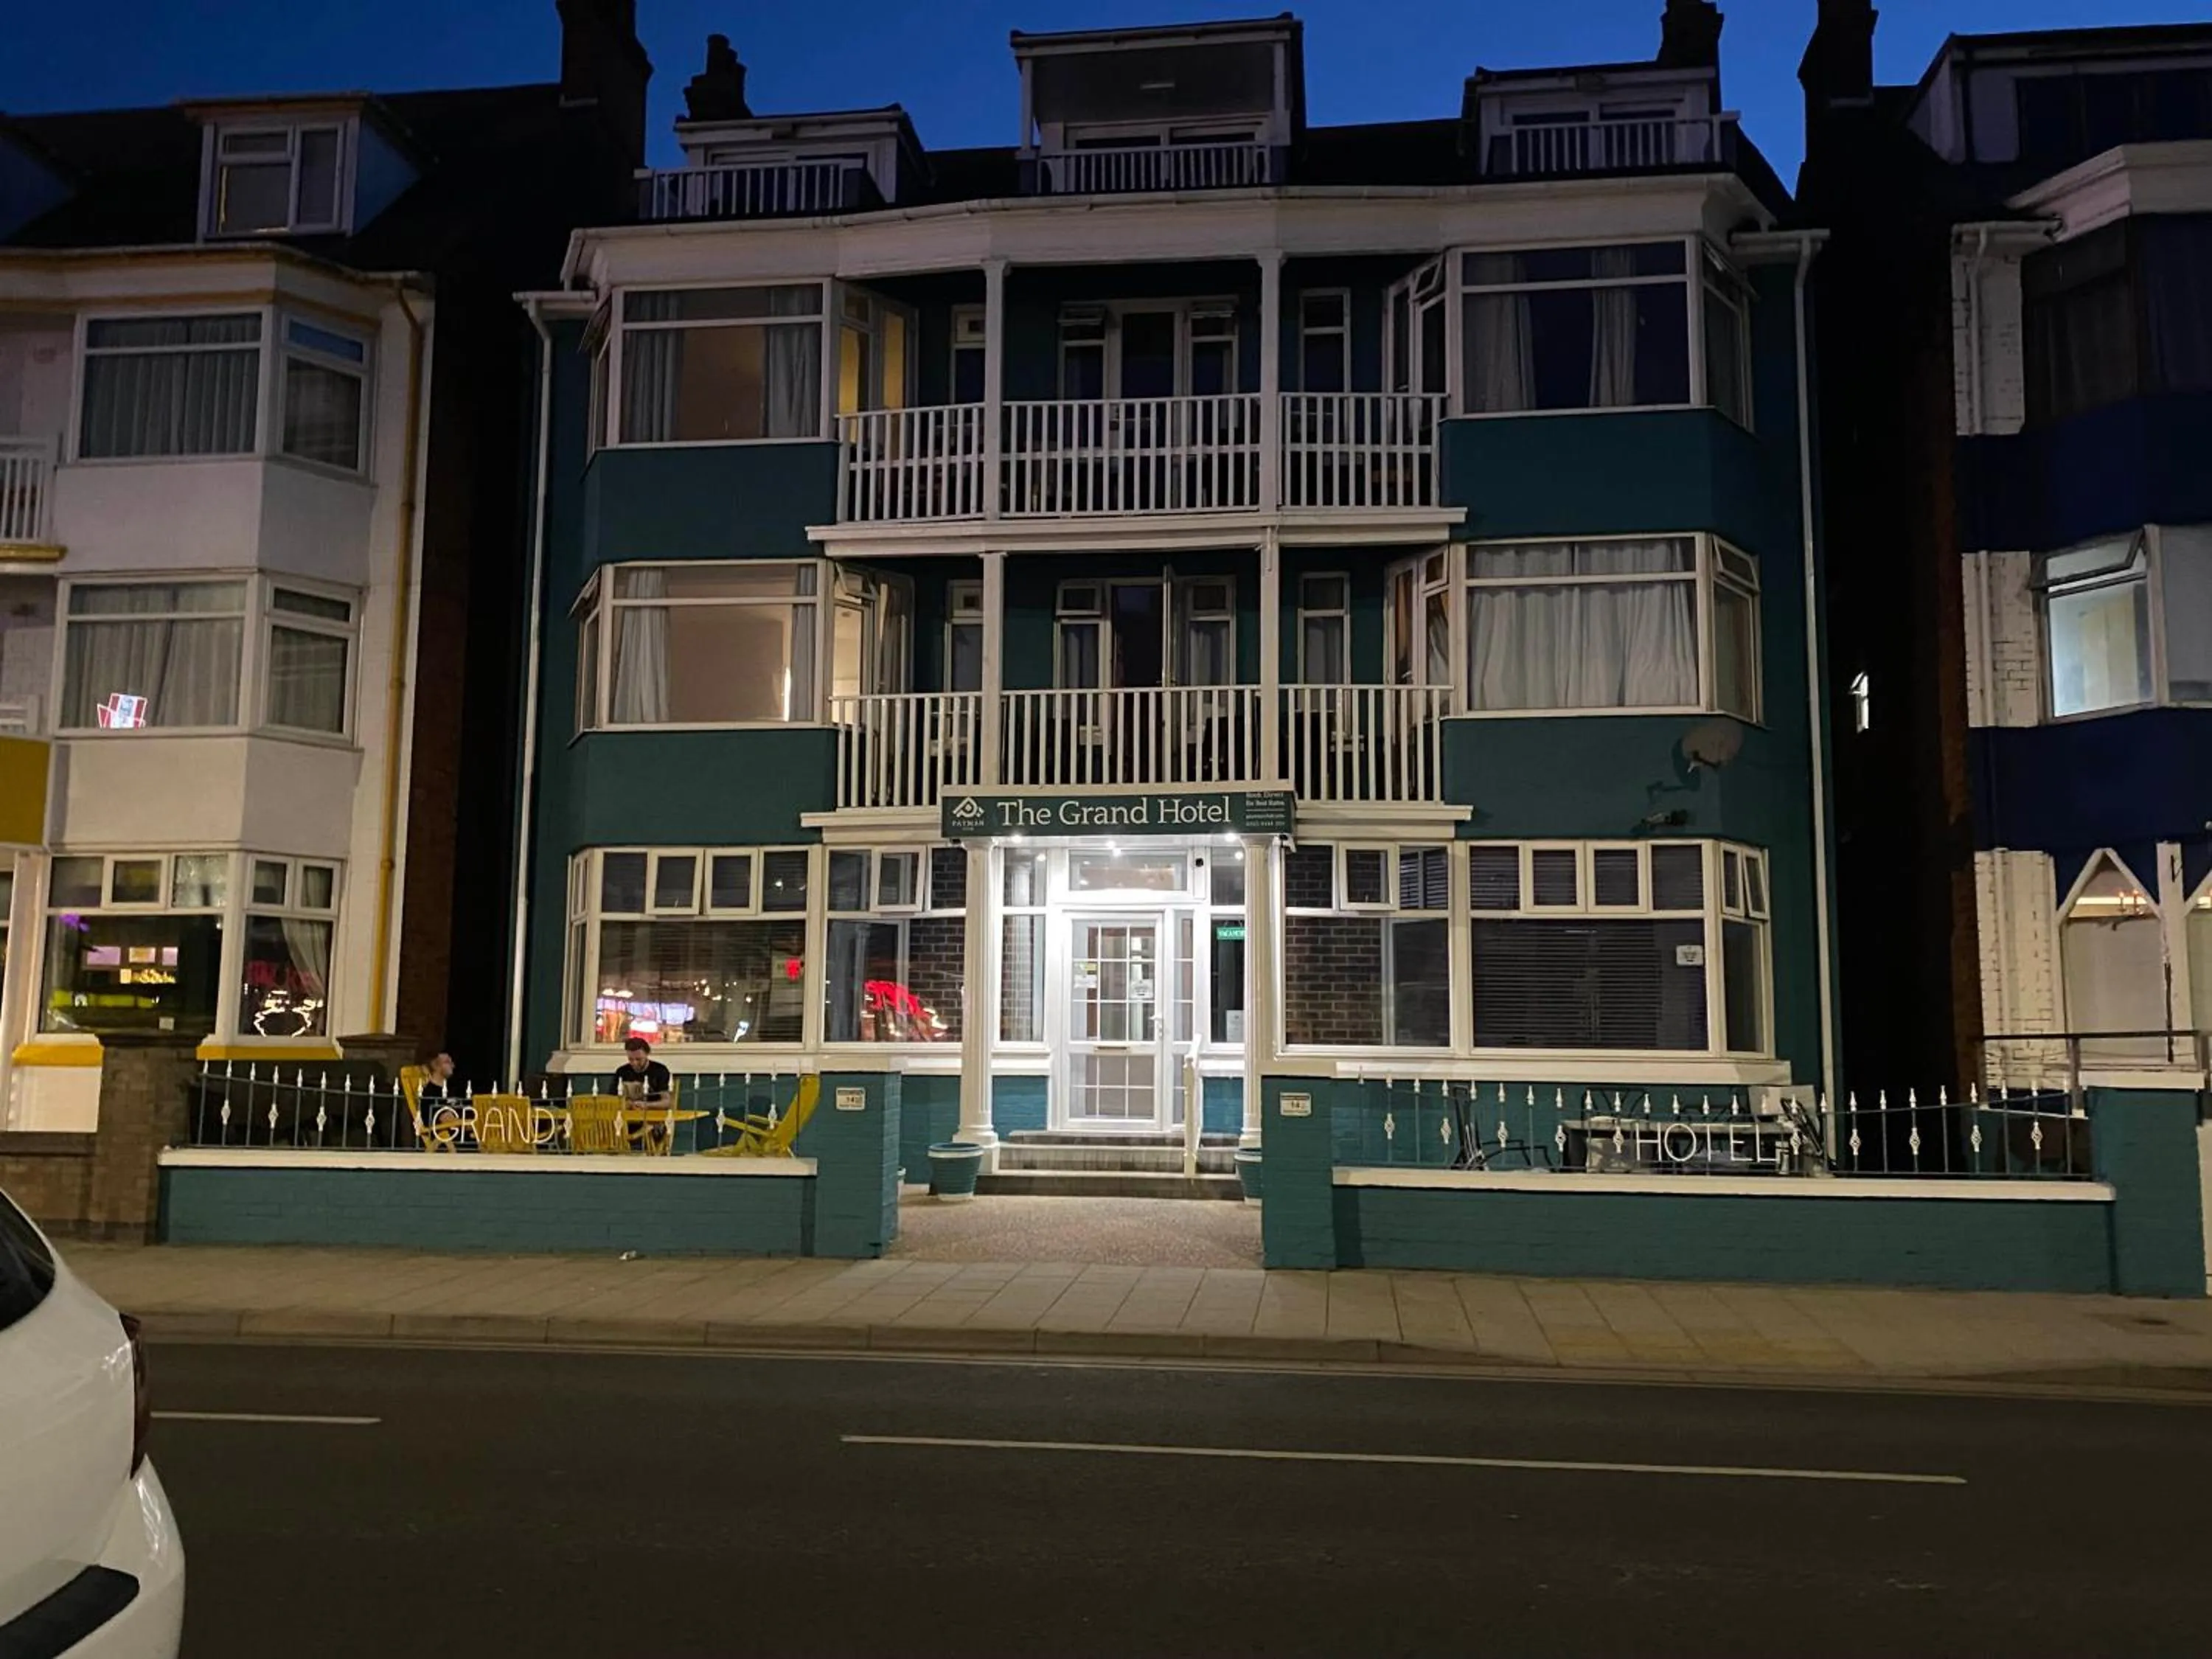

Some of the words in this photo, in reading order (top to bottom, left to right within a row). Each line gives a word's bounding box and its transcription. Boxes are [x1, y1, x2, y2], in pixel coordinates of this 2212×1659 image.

[997, 799, 1051, 826] The
[1059, 797, 1150, 825] Grand
[1157, 796, 1232, 824] Hotel
[433, 1106, 554, 1144] GRAND
[1635, 1121, 1779, 1163] HOTEL
